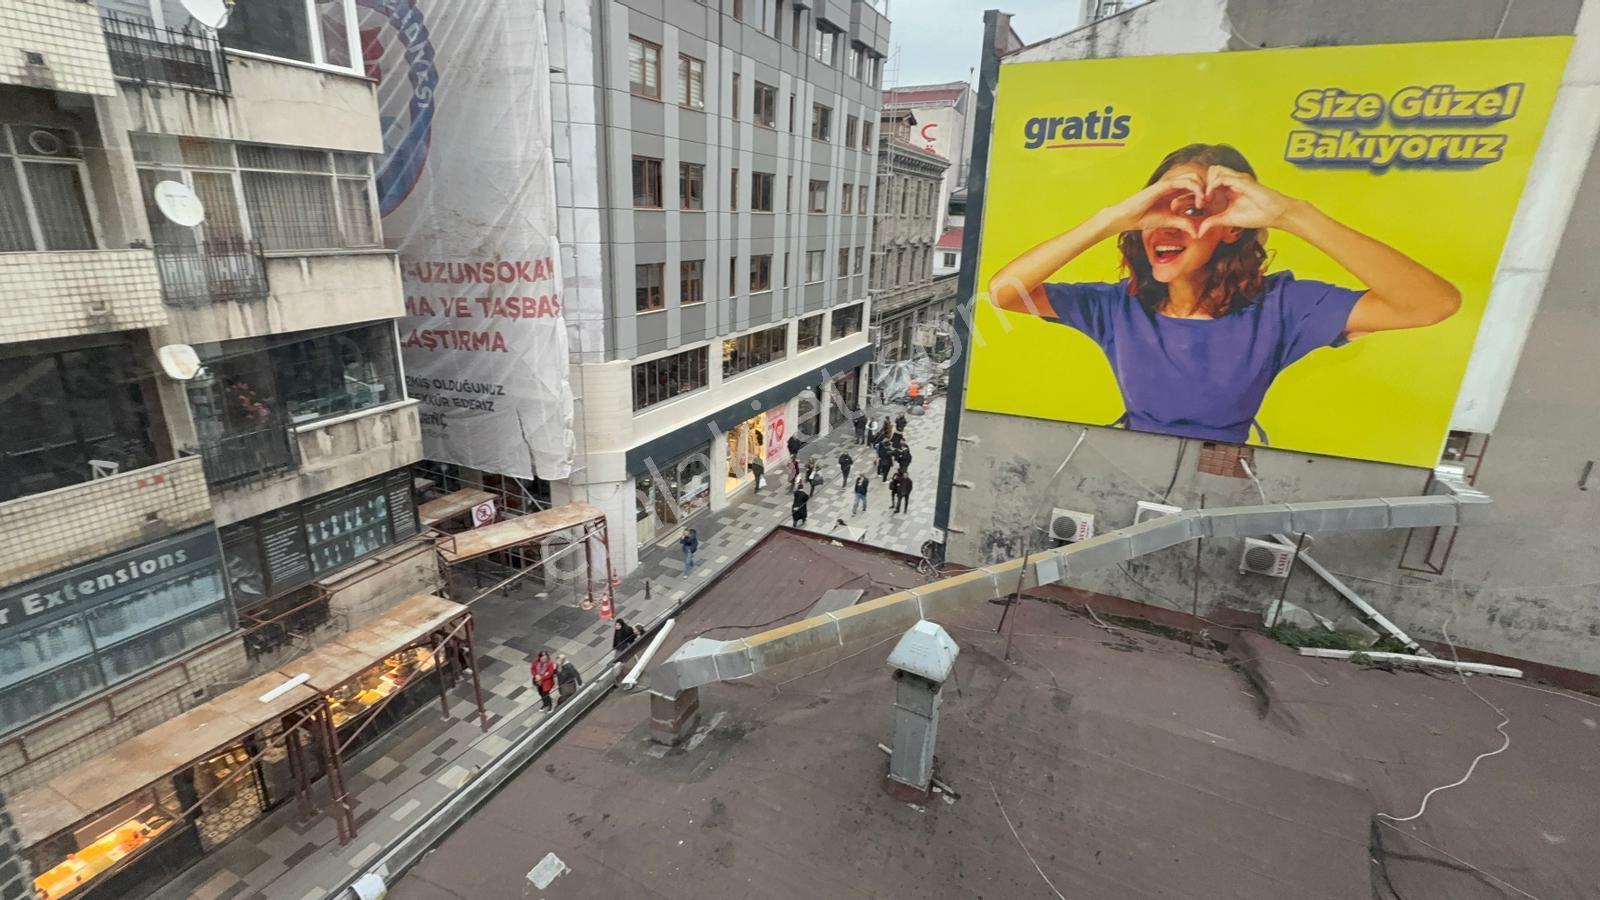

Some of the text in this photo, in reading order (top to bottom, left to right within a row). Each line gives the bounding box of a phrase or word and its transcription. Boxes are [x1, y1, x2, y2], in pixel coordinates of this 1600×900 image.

[1292, 83, 1523, 122] Size Güzel
[1024, 106, 1131, 149] gratis
[1285, 130, 1506, 170] Bakıyoruz
[440, 297, 472, 318] VE
[400, 329, 508, 352] AŞTIRMA
[21, 549, 188, 616] Extensions
